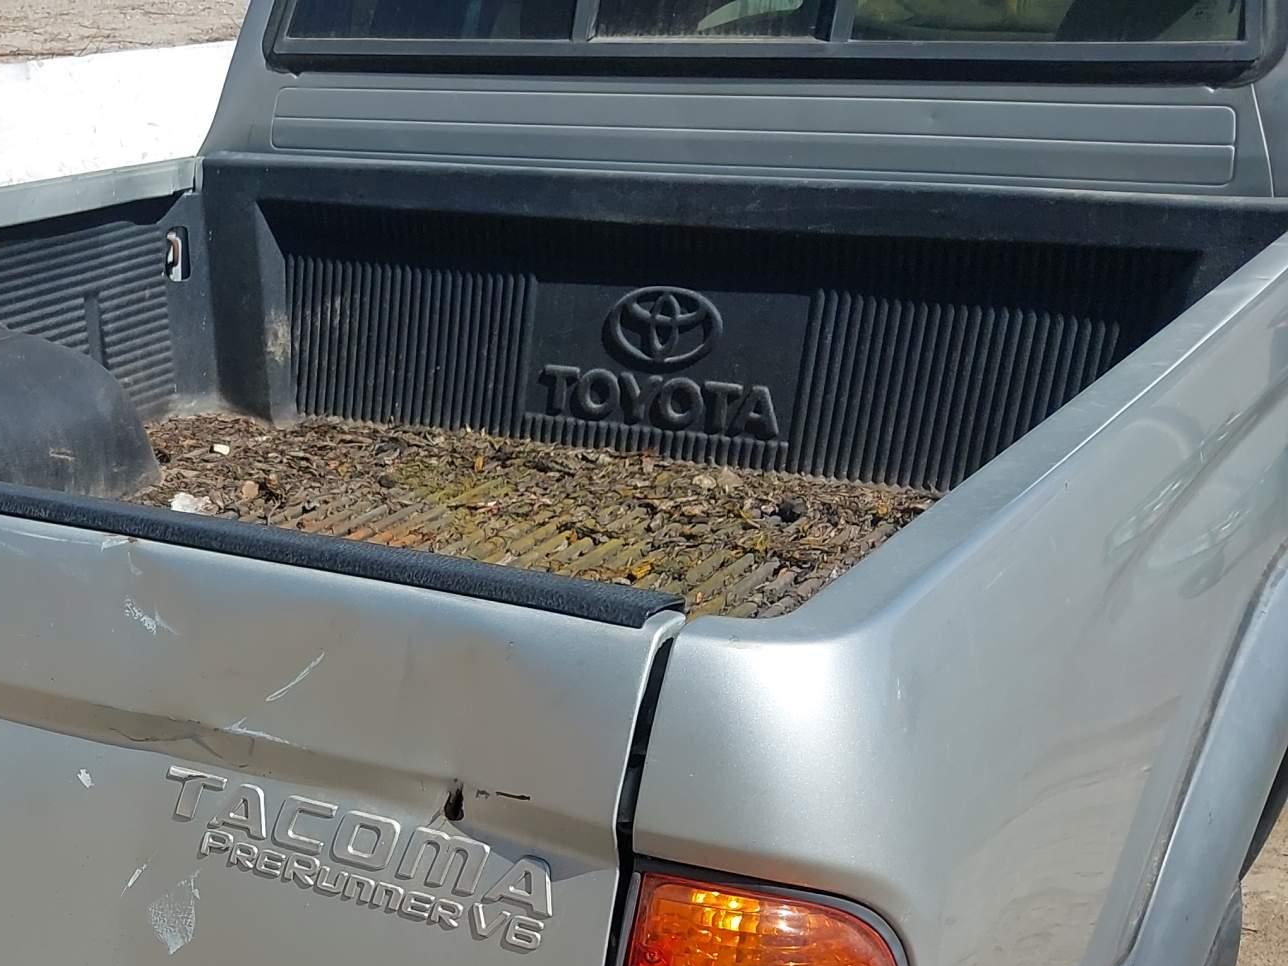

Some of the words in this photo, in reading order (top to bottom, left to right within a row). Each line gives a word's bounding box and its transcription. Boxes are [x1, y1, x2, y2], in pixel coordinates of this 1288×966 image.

[538, 363, 780, 440] TOYOTA
[166, 765, 553, 920] TACOMA
[469, 902, 545, 954] V6
